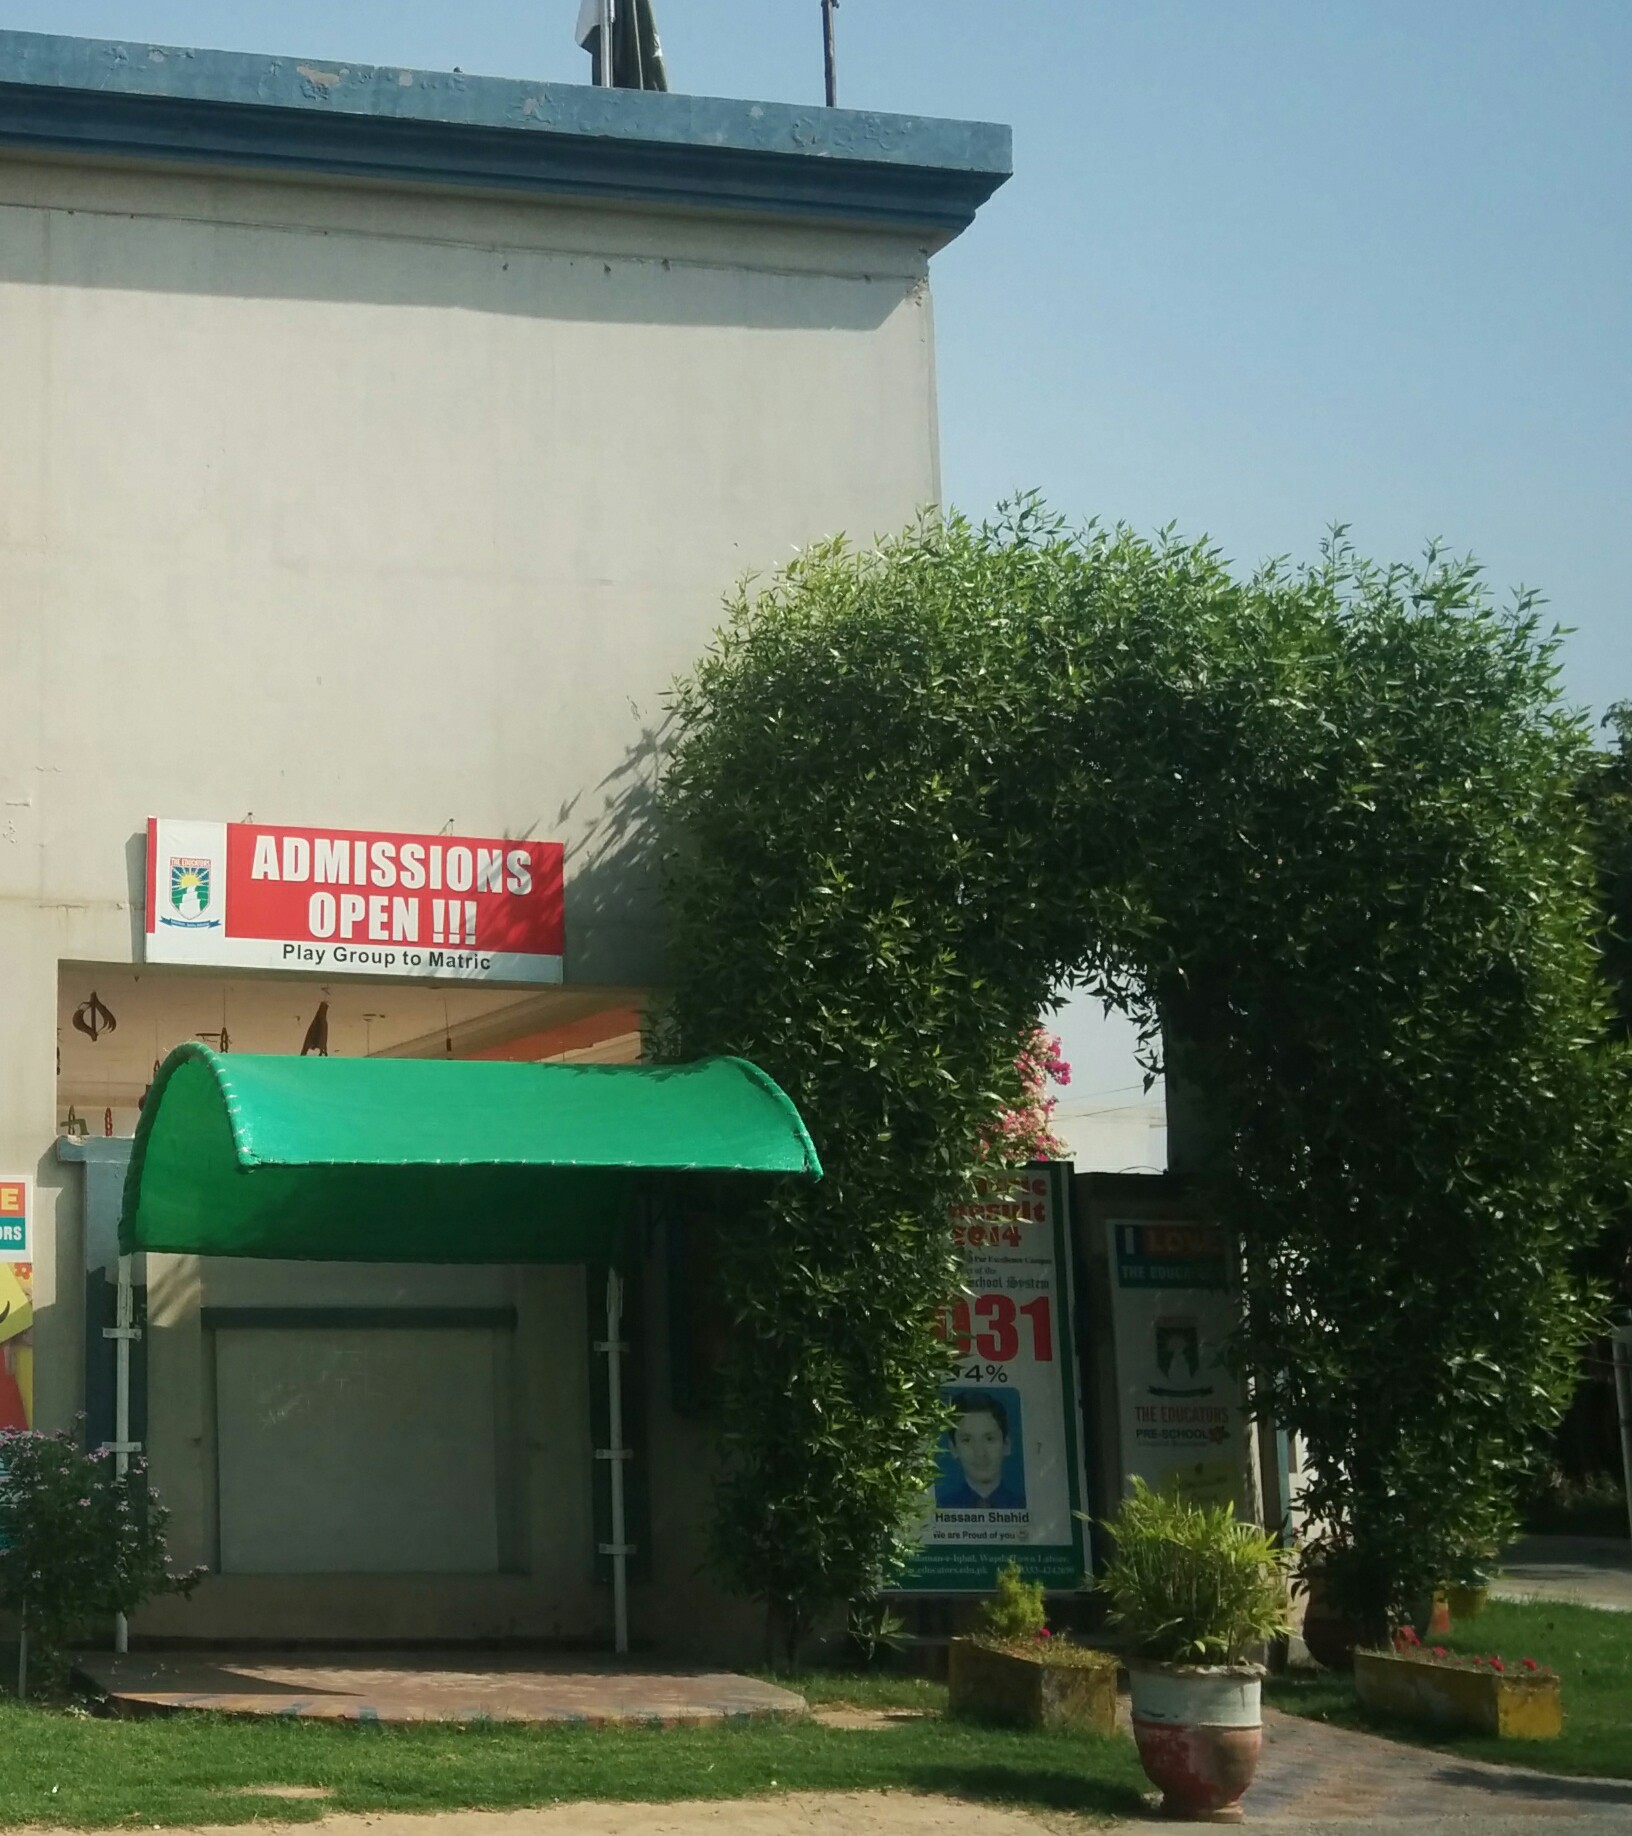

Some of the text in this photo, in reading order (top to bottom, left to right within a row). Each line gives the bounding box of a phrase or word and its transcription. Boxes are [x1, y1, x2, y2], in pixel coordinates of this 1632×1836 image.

[252, 835, 532, 895] ADMISSIONS
[308, 892, 477, 945] OPEN !!!
[284, 944, 494, 970] Play Group to Matric
[1135, 1407, 1229, 1423] THE EDUCATORS
[1136, 1429, 1208, 1439] PRE-SCHOOL
[935, 1512, 1029, 1523] Hassaan Shahid
[948, 1531, 960, 1539] are
[962, 1531, 987, 1539] Proud
[989, 1531, 997, 1539] of
[1000, 1532, 1015, 1541] you
